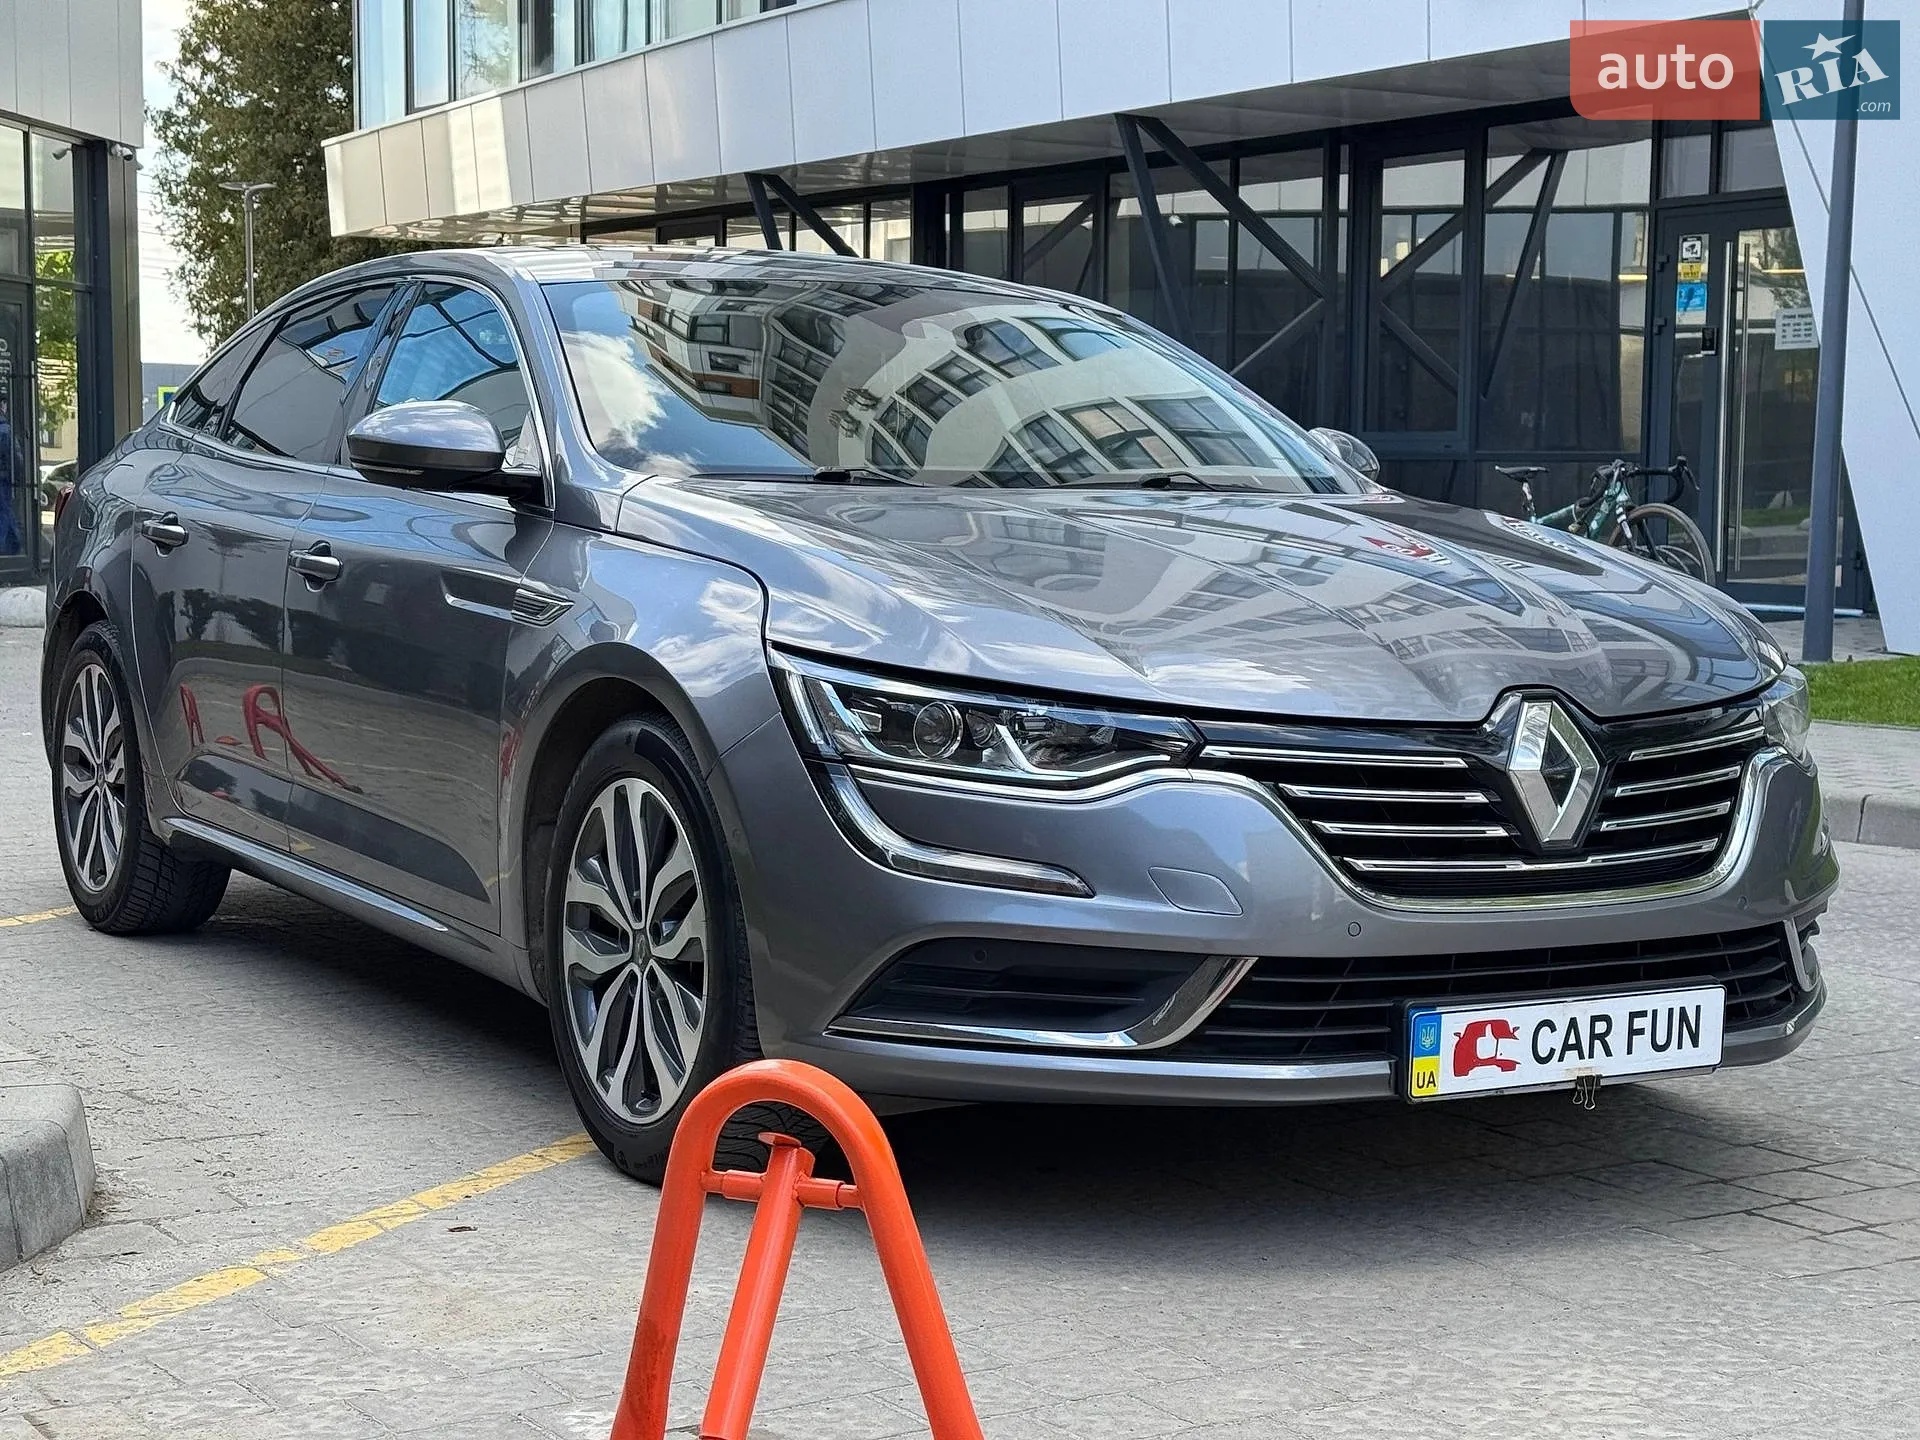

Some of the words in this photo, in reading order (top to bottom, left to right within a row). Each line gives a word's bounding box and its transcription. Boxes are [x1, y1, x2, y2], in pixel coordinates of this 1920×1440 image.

[1531, 1014, 1613, 1065] CAR
[1626, 1004, 1702, 1056] FUN
[1416, 1070, 1437, 1089] UA
